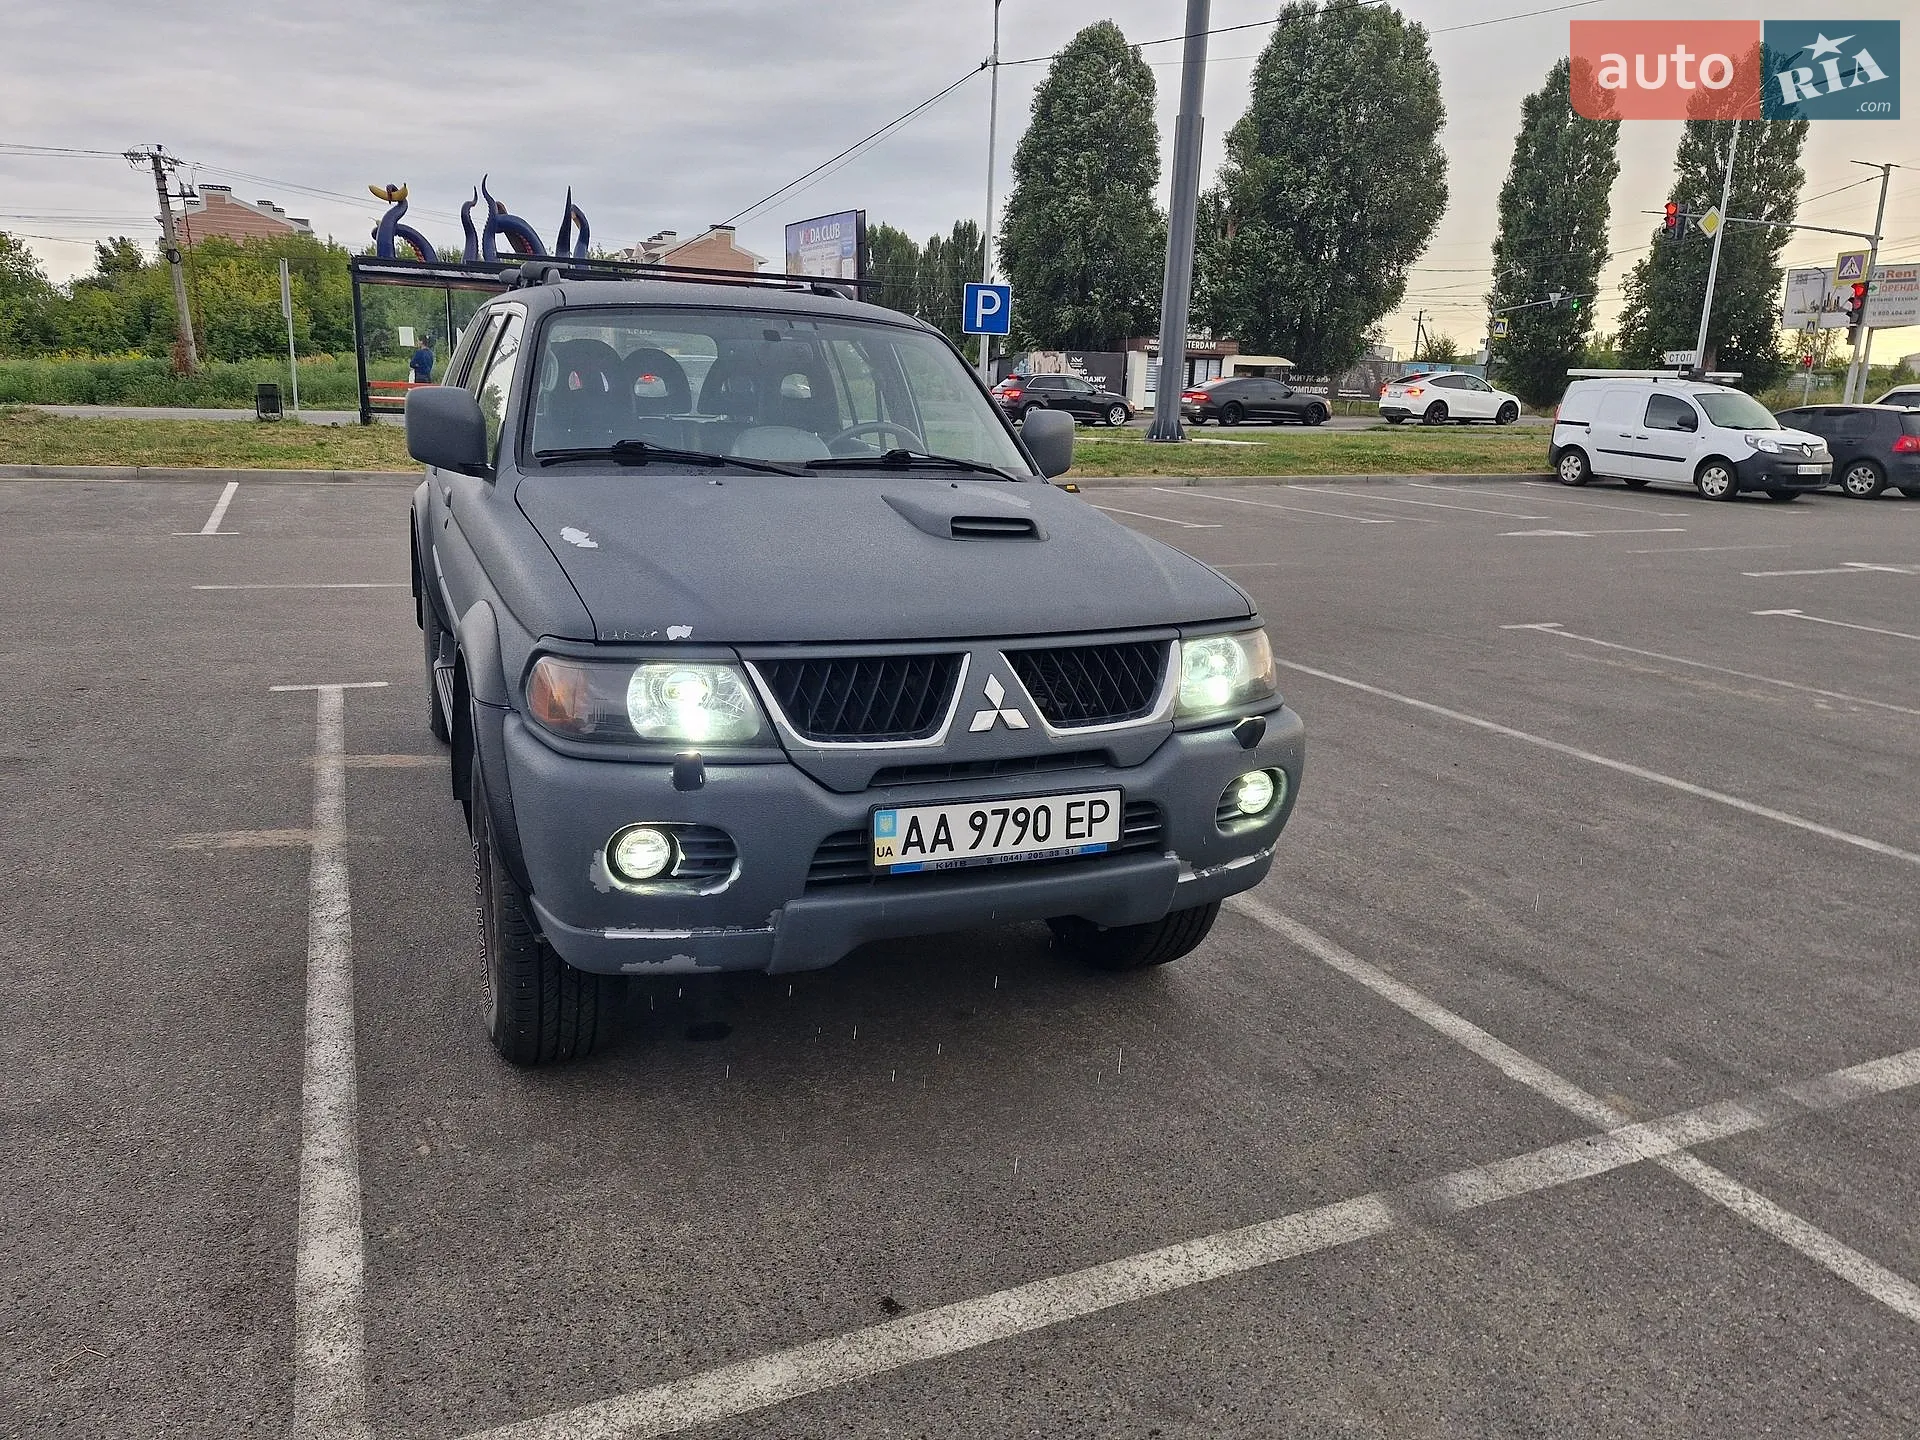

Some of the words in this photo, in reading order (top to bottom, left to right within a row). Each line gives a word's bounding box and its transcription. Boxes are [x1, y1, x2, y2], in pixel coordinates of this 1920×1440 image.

[821, 223, 841, 241] CLUB
[976, 289, 1001, 328] P
[1186, 341, 1216, 350] TERDAM
[1669, 353, 1692, 362] СТОП
[901, 813, 954, 855] AA
[968, 804, 1050, 850] 9790
[1065, 799, 1110, 840] EP
[876, 846, 893, 857] UA
